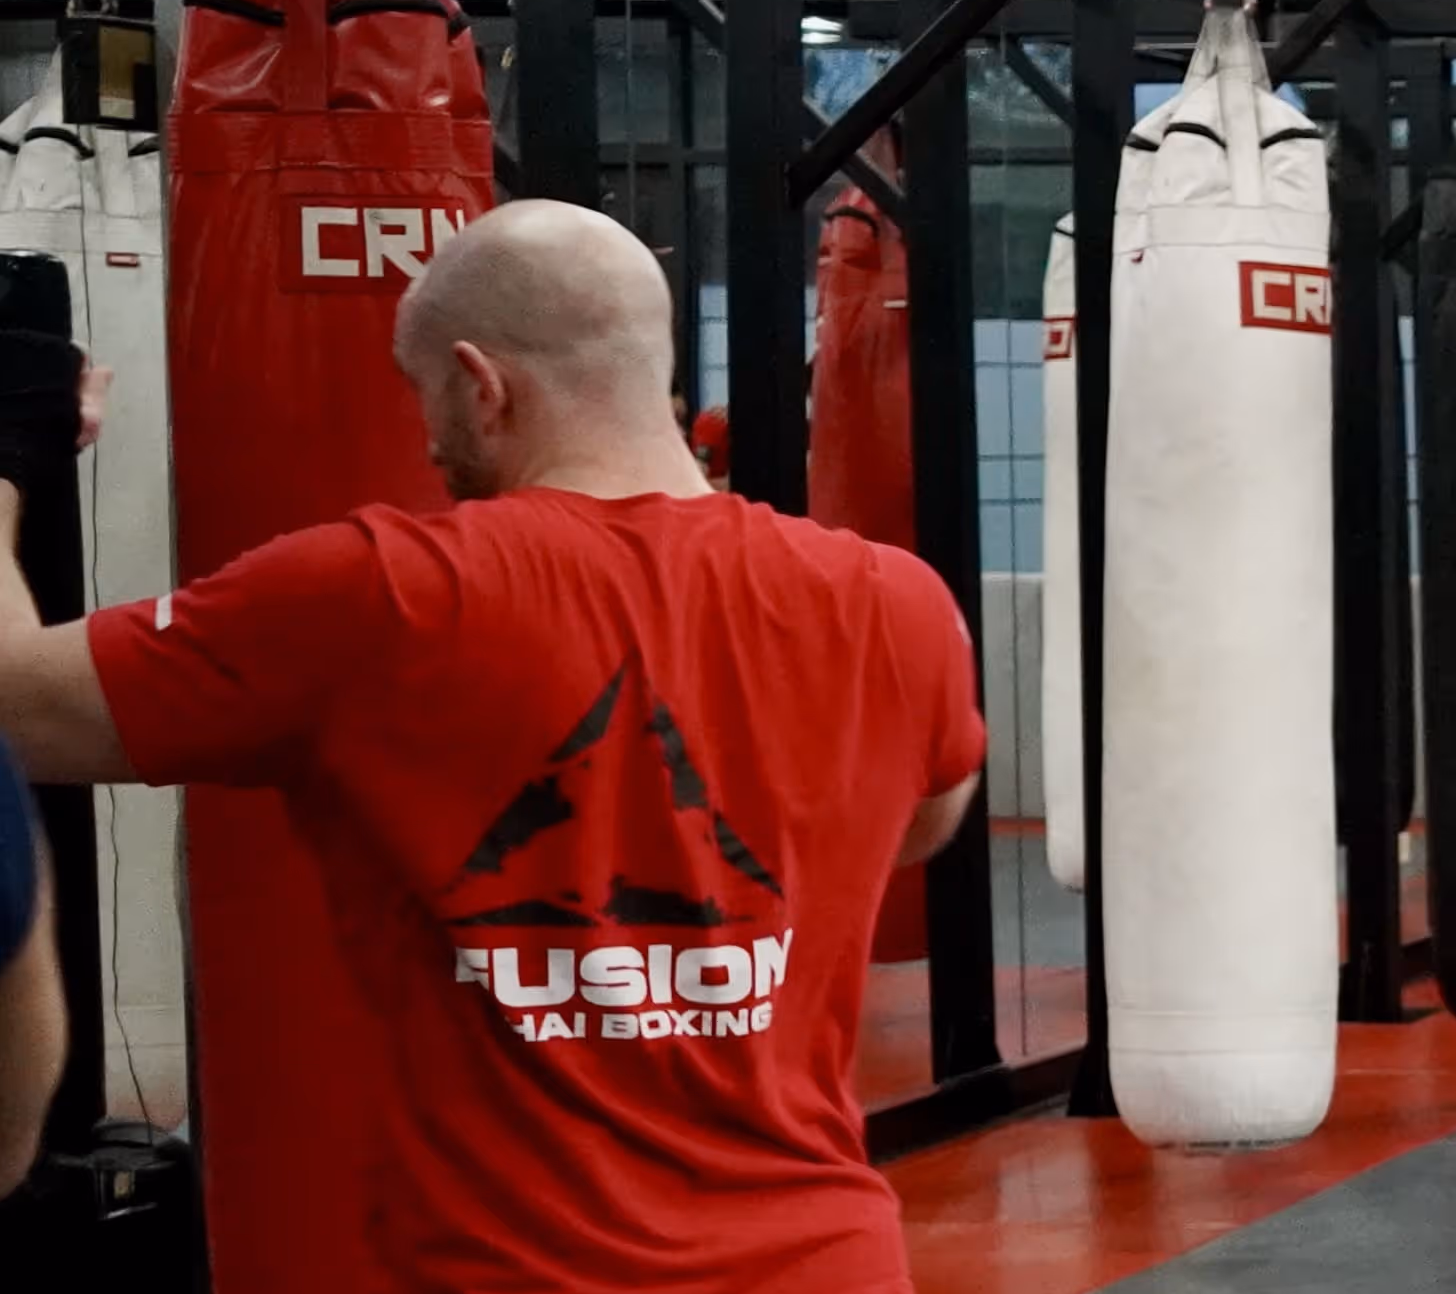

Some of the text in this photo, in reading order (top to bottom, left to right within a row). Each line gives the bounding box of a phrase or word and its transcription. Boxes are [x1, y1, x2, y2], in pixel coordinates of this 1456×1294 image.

[455, 927, 794, 1007] FUSION
[505, 1001, 773, 1042] HAI BOXING
